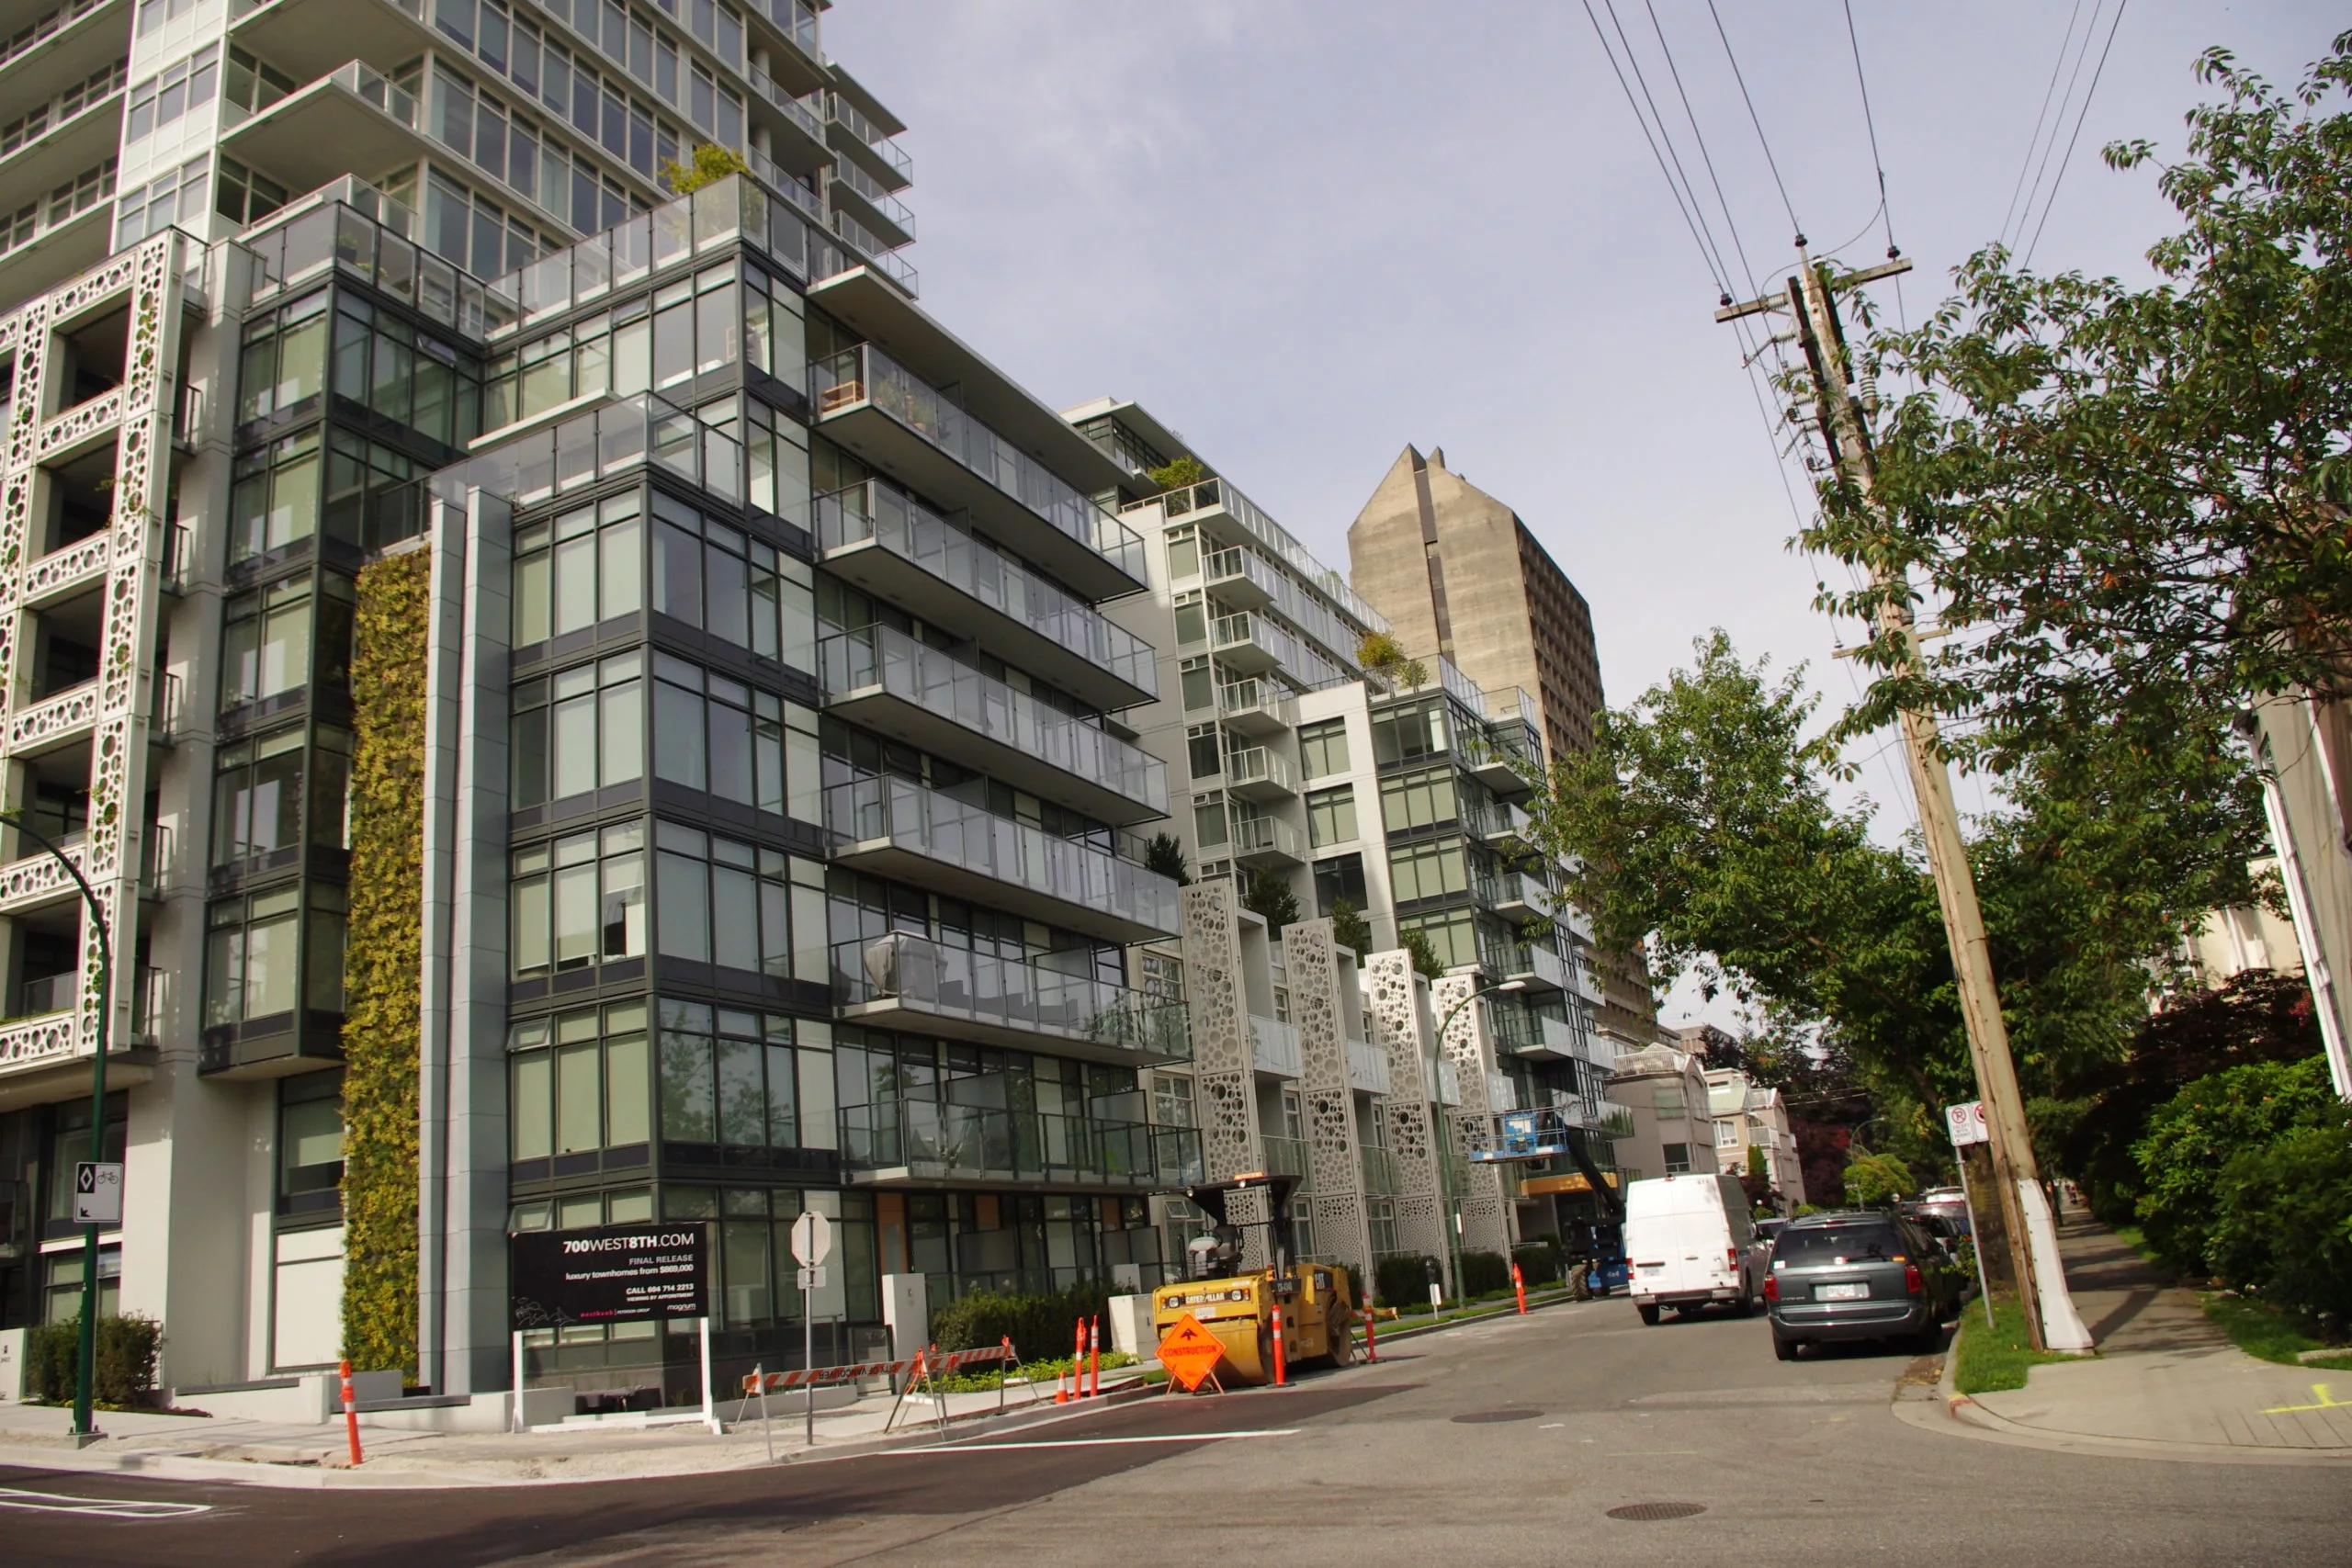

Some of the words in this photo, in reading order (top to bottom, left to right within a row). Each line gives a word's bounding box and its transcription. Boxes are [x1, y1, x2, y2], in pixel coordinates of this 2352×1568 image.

[563, 1233, 694, 1253] 700WEST8TH.COM
[628, 1257, 654, 1266] FINAL
[655, 1254, 694, 1264] RELEASE
[565, 1272, 591, 1280] luxury
[592, 1269, 639, 1280] townhomes
[639, 1267, 659, 1276] from
[626, 1286, 646, 1295] CALL
[662, 1284, 676, 1292] 714
[676, 1282, 695, 1292] 2213
[1164, 1344, 1217, 1358] CONSTRUCTION
